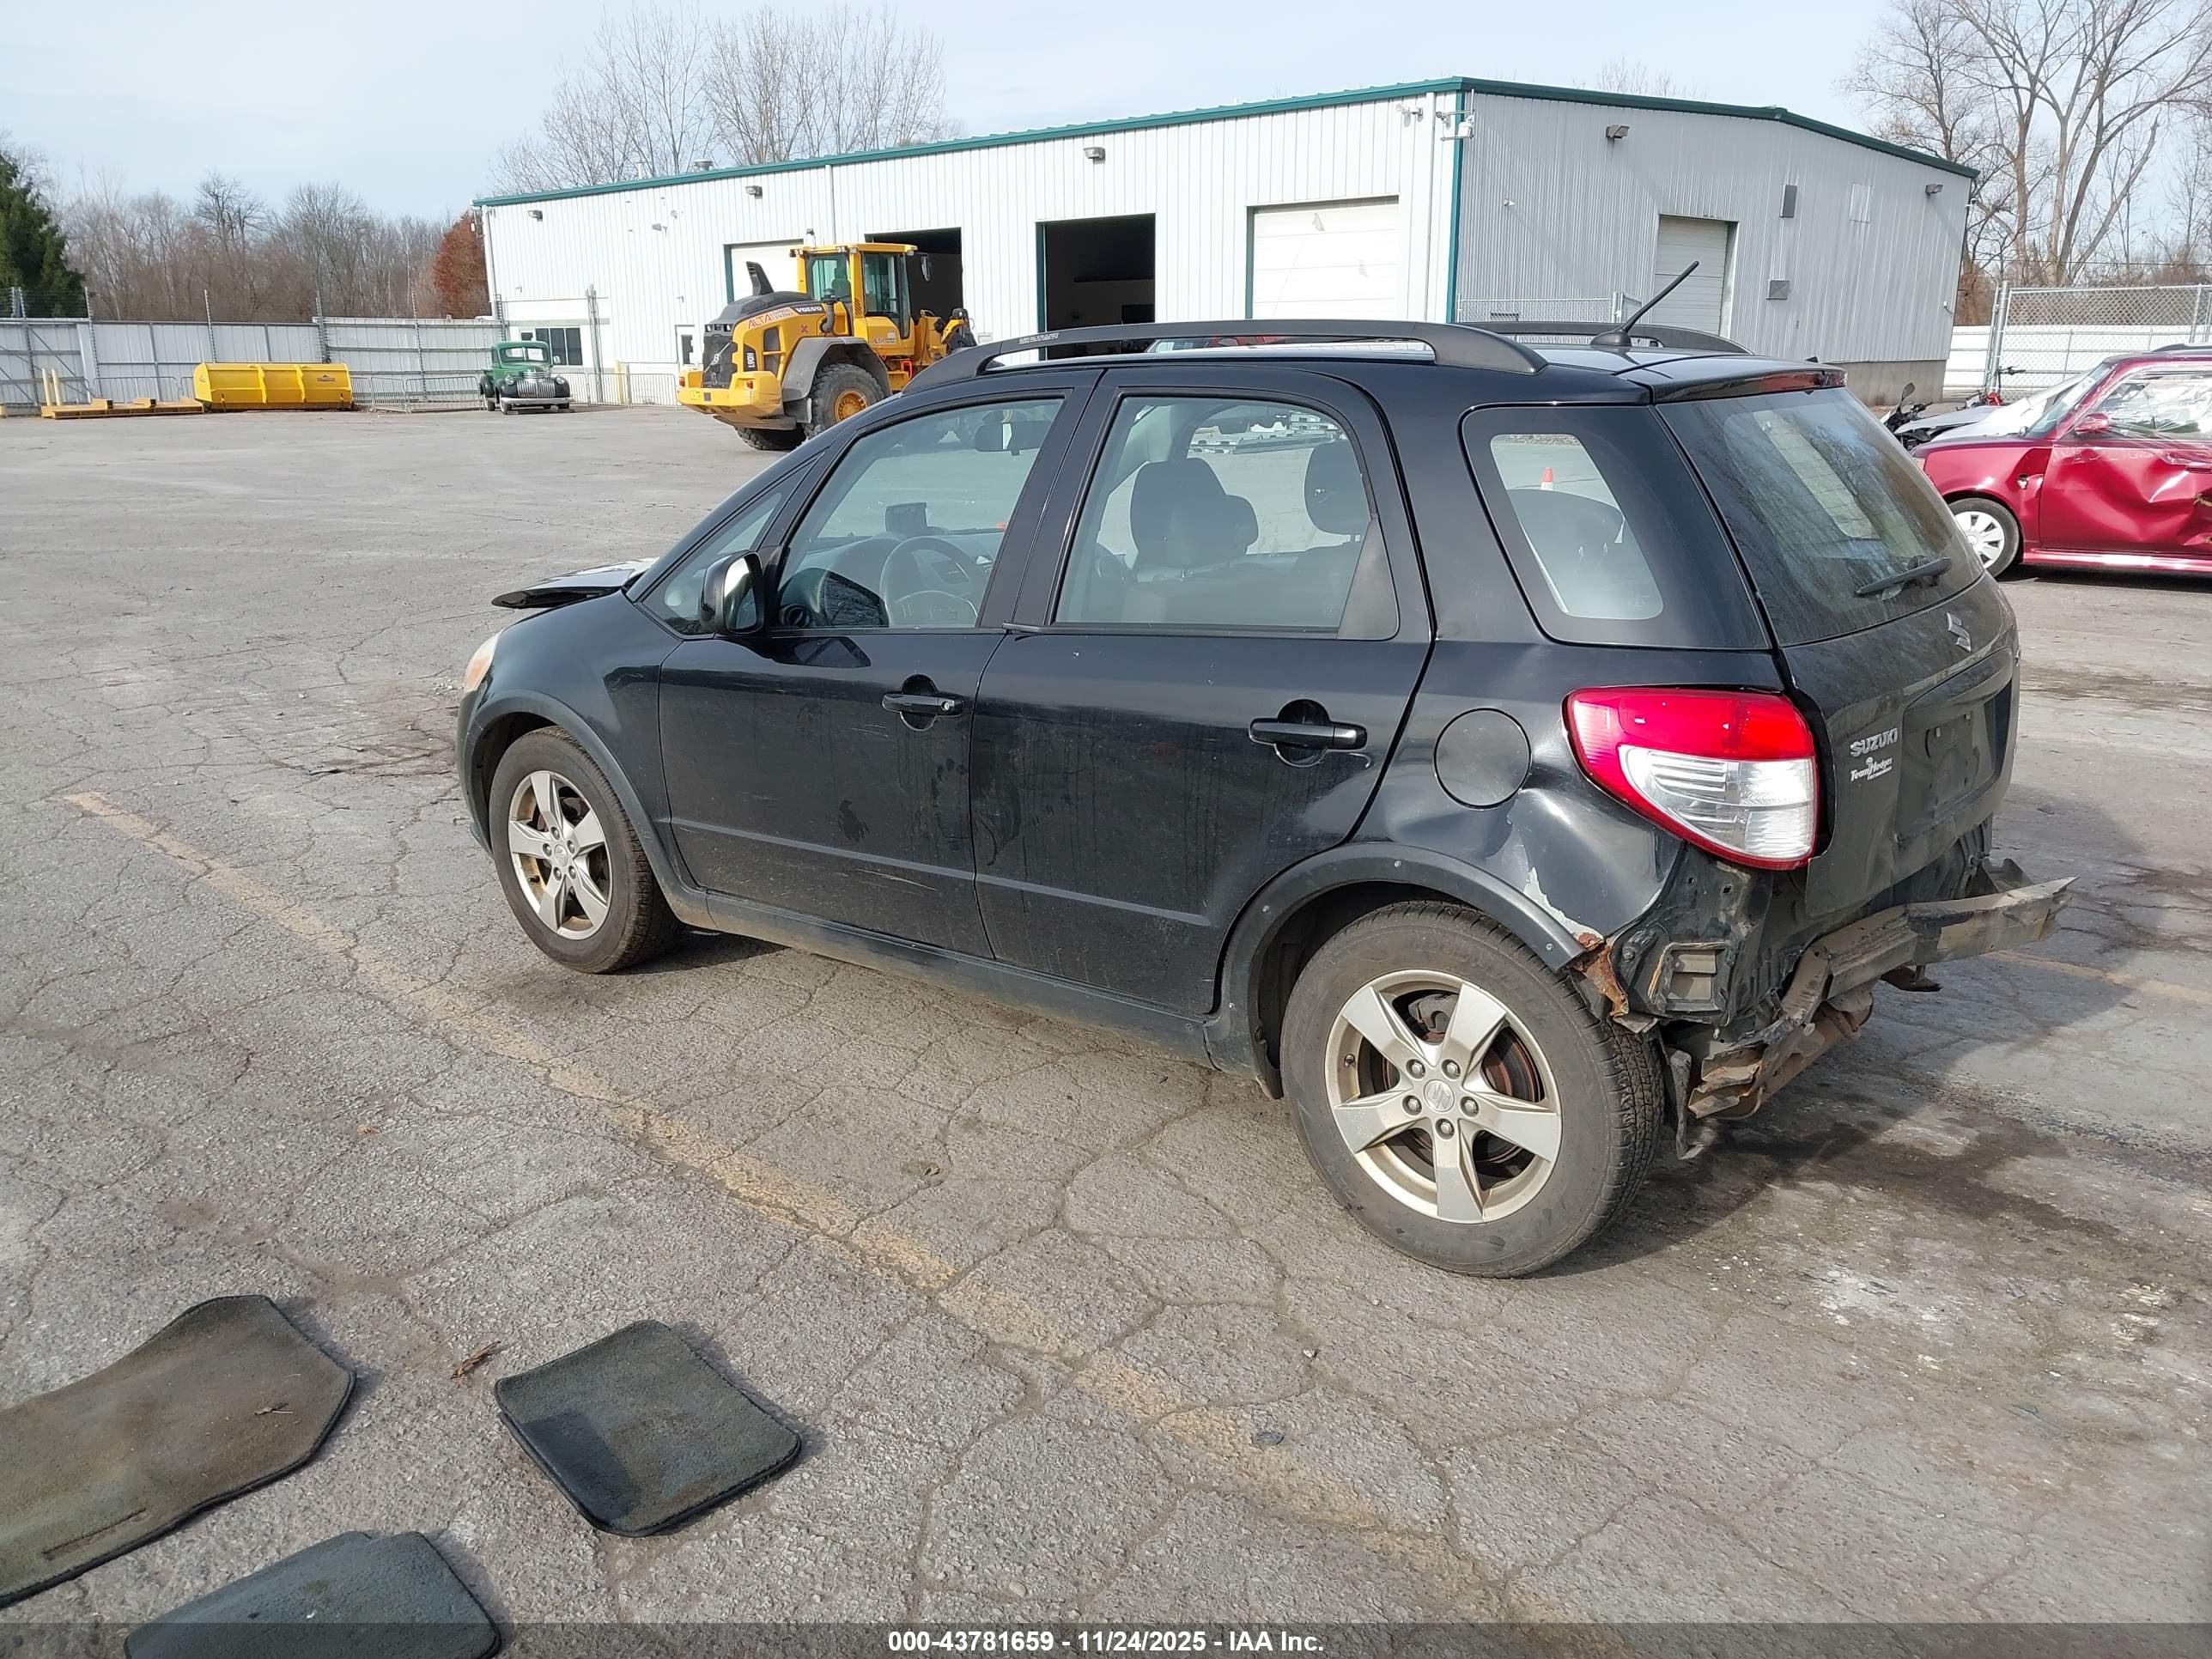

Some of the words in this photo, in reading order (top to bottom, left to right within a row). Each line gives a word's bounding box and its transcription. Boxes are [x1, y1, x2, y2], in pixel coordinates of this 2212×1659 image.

[748, 313, 772, 329] ALTA
[746, 352, 756, 368] L90H
[1850, 727, 1898, 757] SUZUKI
[1850, 768, 1870, 781] Team
